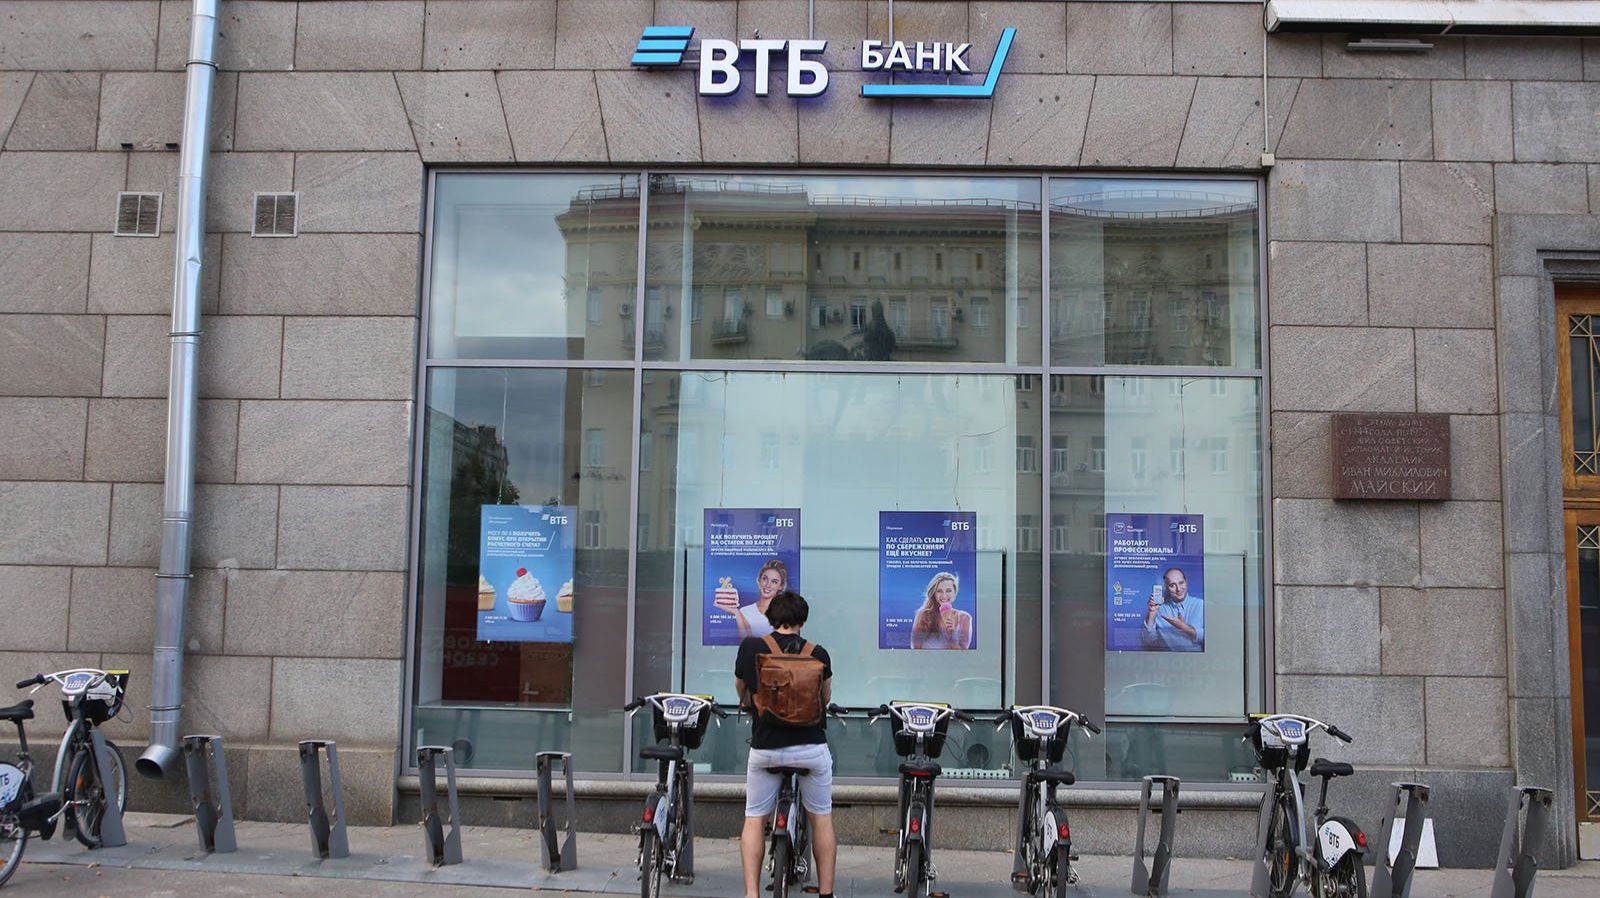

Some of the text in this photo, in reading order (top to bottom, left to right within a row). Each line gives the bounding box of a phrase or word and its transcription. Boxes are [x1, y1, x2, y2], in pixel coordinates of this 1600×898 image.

[699, 38, 973, 97] ВТБ БАНК
[1342, 466, 1371, 477] ИВАН
[549, 515, 568, 525] ВТБ
[775, 518, 794, 527] ВТБ
[951, 521, 970, 531] ВТБ
[1178, 524, 1197, 533] ВТБ
[1113, 546, 1174, 554] ПРОФЕССИОНАЛЫ
[0, 773, 10, 786] ТБ
[1328, 831, 1340, 849] ВТБ
